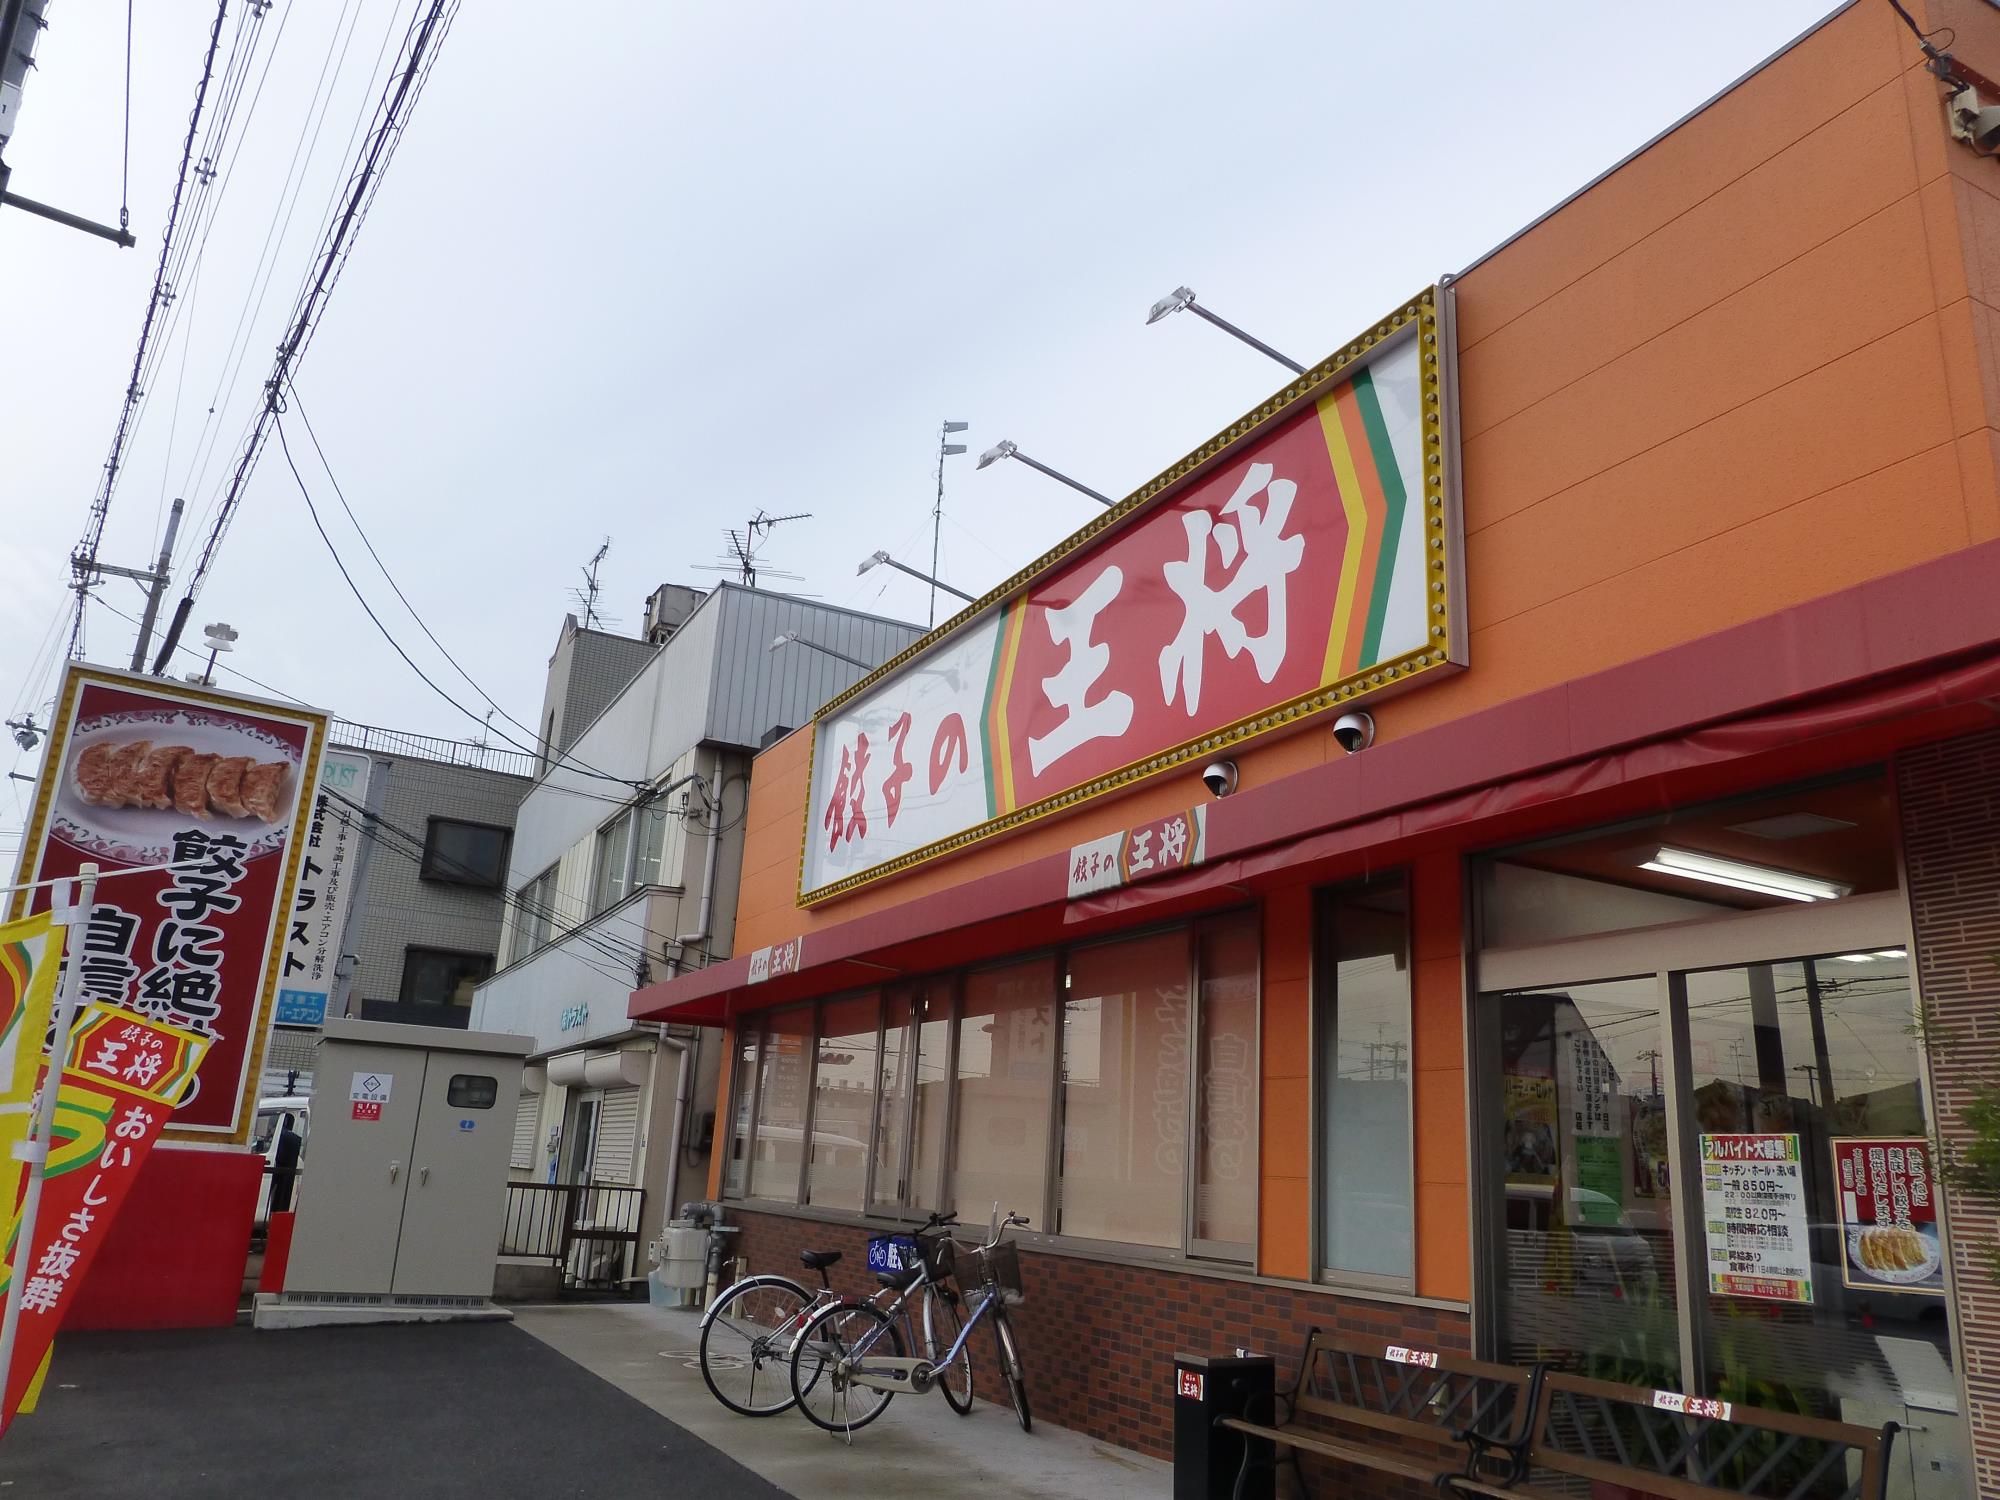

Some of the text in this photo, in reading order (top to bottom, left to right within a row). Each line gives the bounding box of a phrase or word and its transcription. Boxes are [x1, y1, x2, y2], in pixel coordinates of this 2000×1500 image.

[825, 463, 1306, 853] 餃子の 王将
[1073, 817, 1187, 883] 餃子の 王将
[284, 855, 323, 977] トラスト
[138, 830, 247, 1107] 餃子に絶
[772, 942, 794, 974] 王将
[87, 1038, 162, 1087] 王将
[120, 1024, 163, 1050] 餃子の
[20, 1105, 152, 1315] おいしさ抜群
[1409, 1350, 1430, 1366] 王将
[1688, 1398, 1720, 1418] 王将
